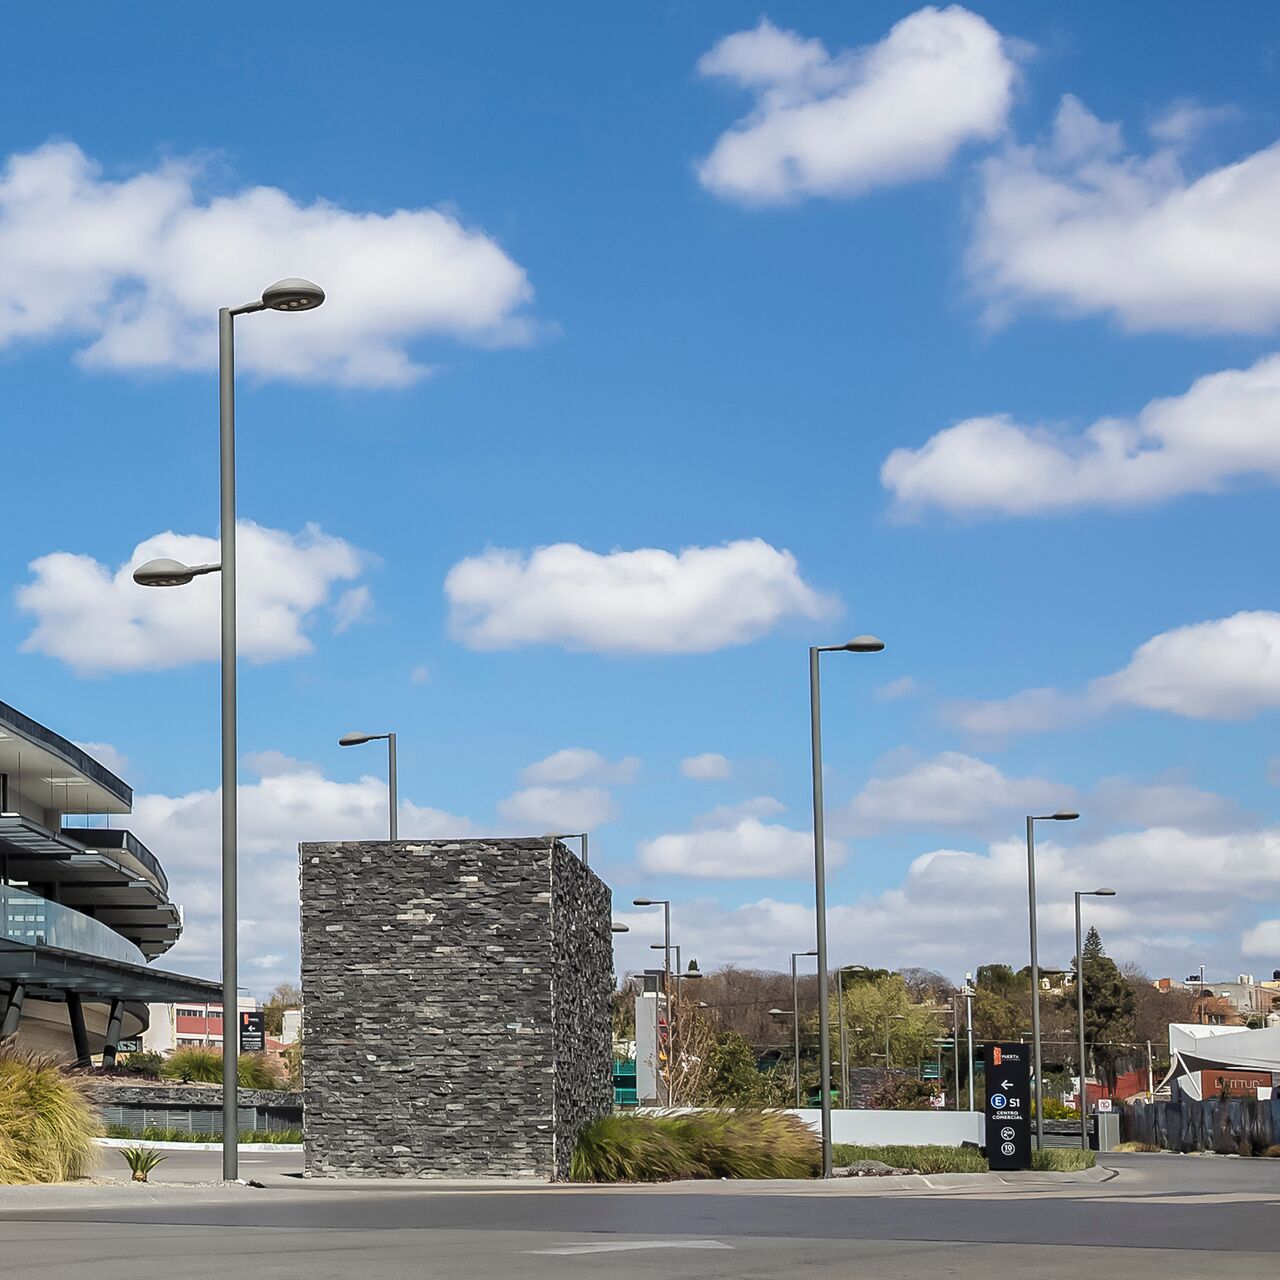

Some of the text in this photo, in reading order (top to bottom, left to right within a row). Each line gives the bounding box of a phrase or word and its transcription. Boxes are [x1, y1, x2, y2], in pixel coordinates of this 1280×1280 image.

[1214, 1079, 1260, 1089] LTITUD
[995, 1097, 1020, 1107] E S1
